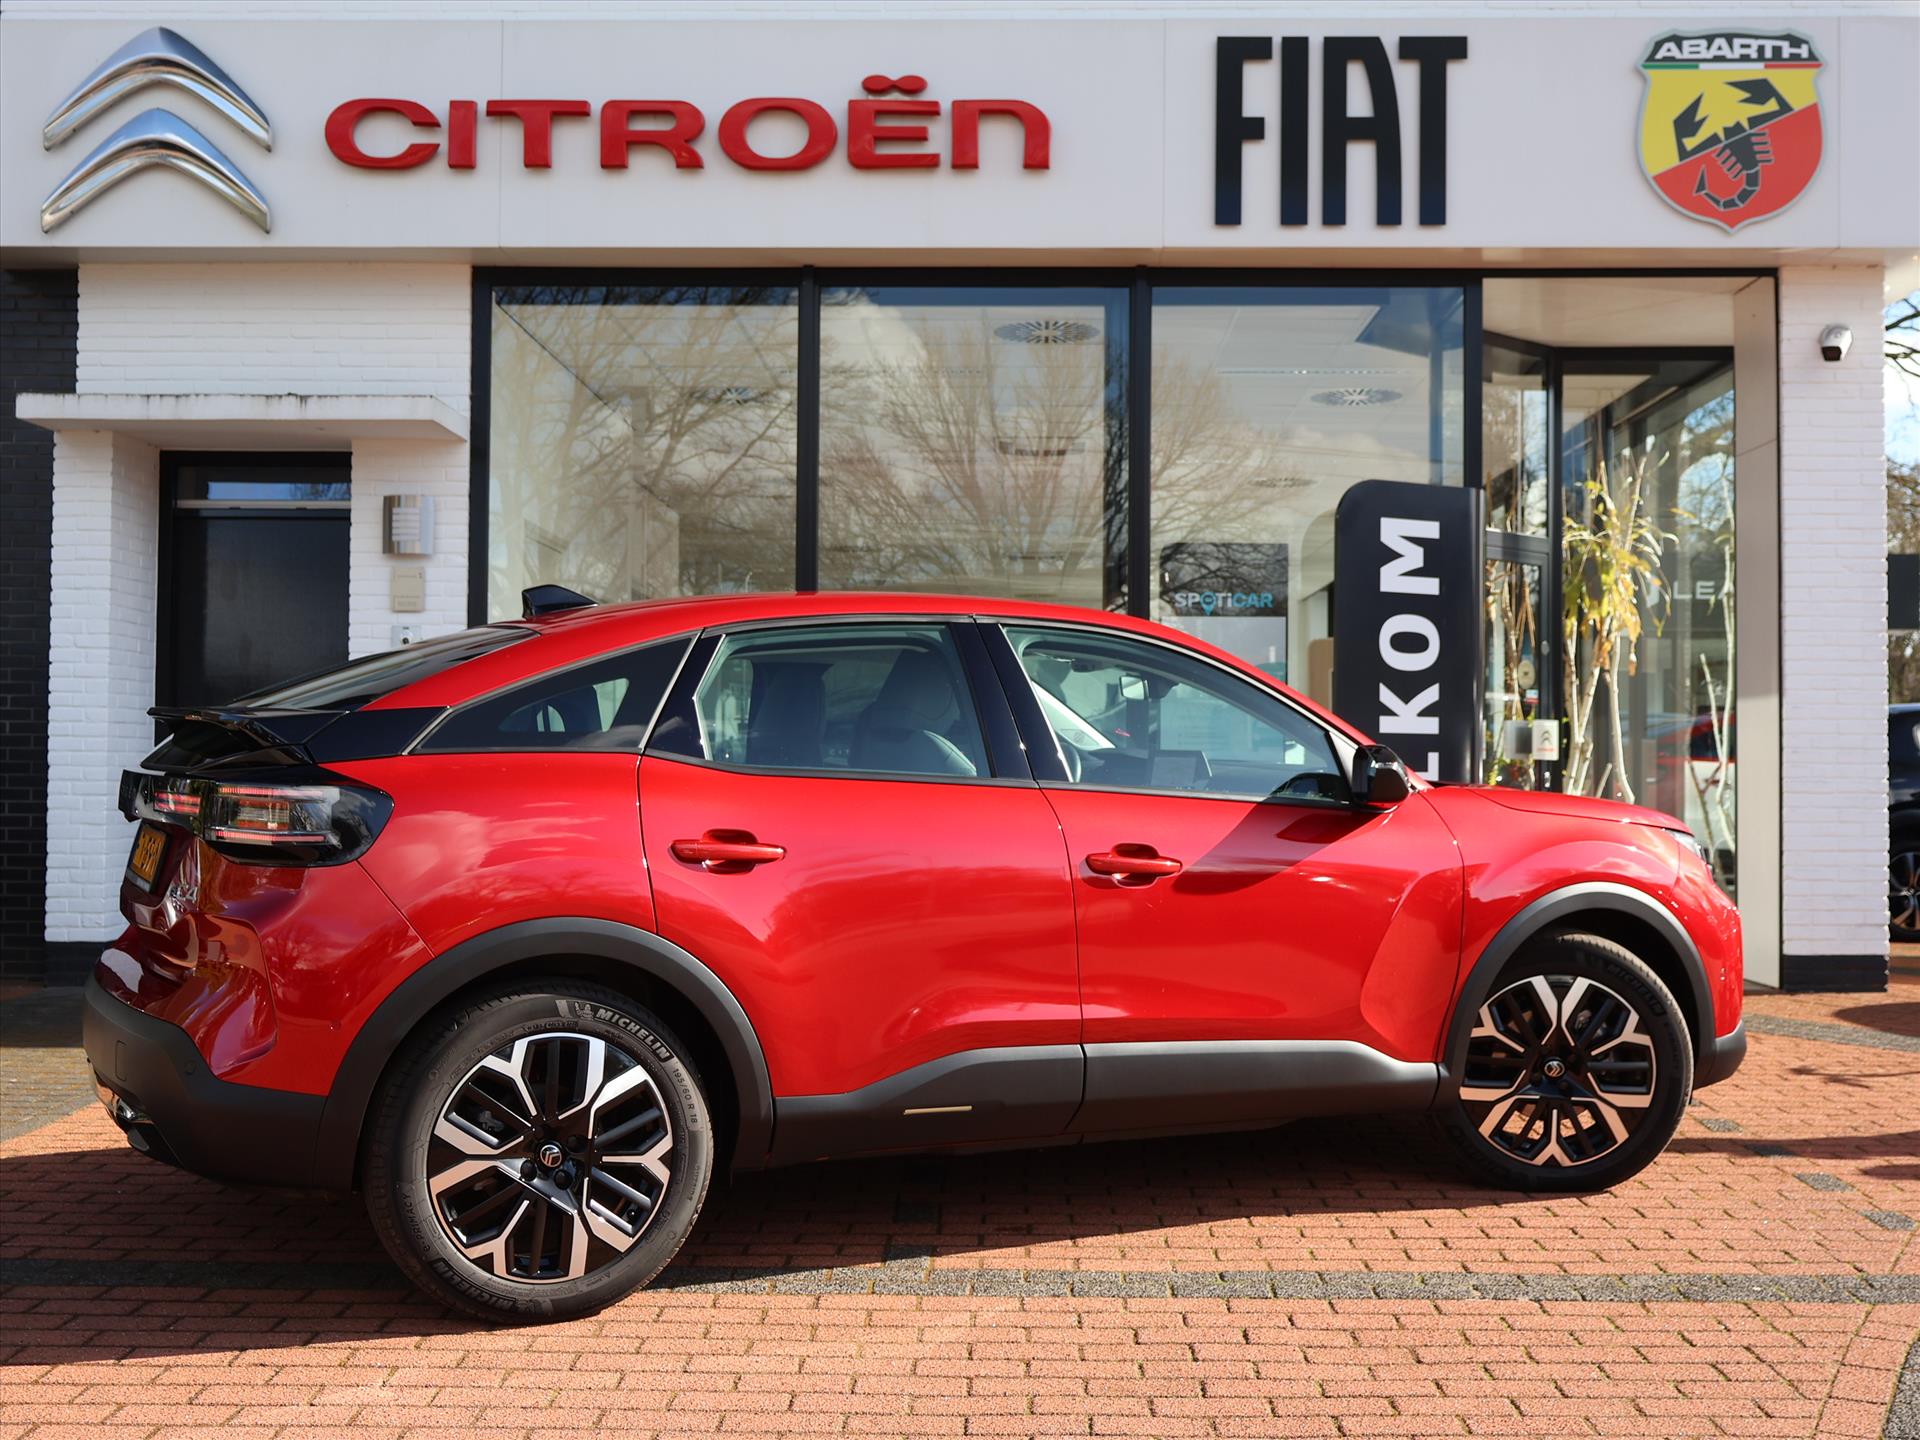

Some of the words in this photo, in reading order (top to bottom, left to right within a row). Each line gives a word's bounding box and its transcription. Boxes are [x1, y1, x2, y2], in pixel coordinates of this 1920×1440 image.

[1654, 38, 1809, 60] ABARTH
[325, 75, 1051, 170] CITROËN
[1215, 36, 1468, 227] FIAT
[595, 1008, 671, 1060] MICHELIN
[672, 1068, 693, 1101] 195/60
[432, 1260, 516, 1311] MICHELIN
